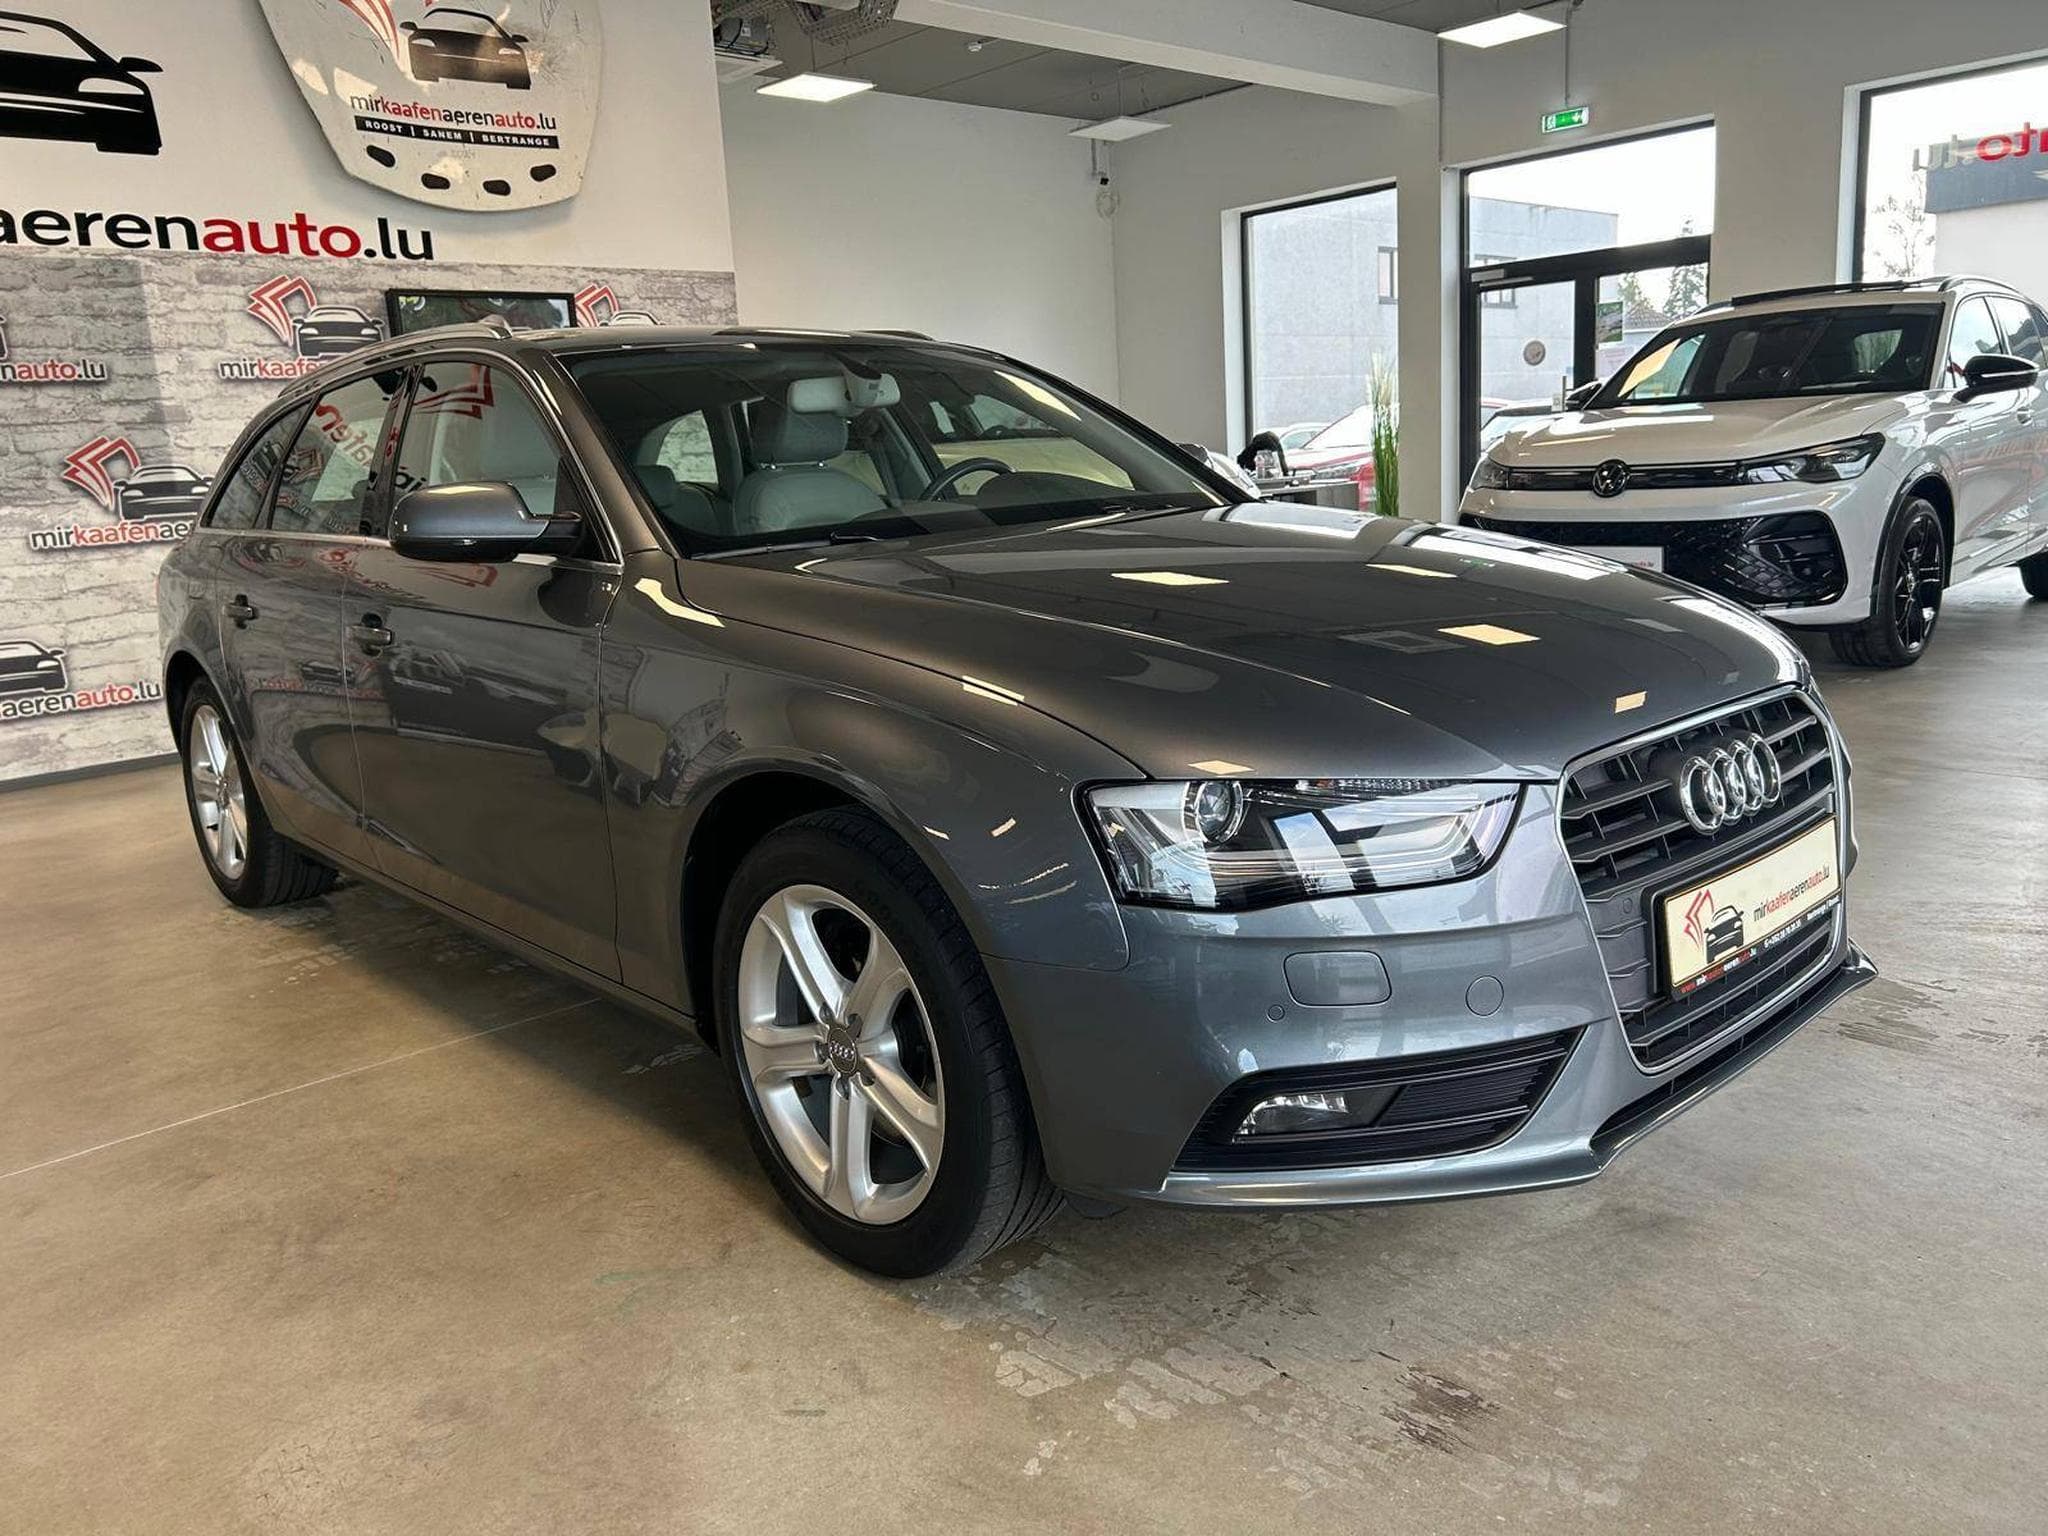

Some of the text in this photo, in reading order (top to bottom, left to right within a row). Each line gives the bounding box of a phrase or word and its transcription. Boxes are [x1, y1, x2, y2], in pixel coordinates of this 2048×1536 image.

[350, 95, 557, 130] mirkaafenaerenauto.lu
[365, 119, 551, 146] ROOST SANEM BERTRANGE
[1, 358, 106, 379] nauto.lu
[31, 521, 193, 548] mirkaafenae
[2, 681, 161, 718] aerenauto.lu
